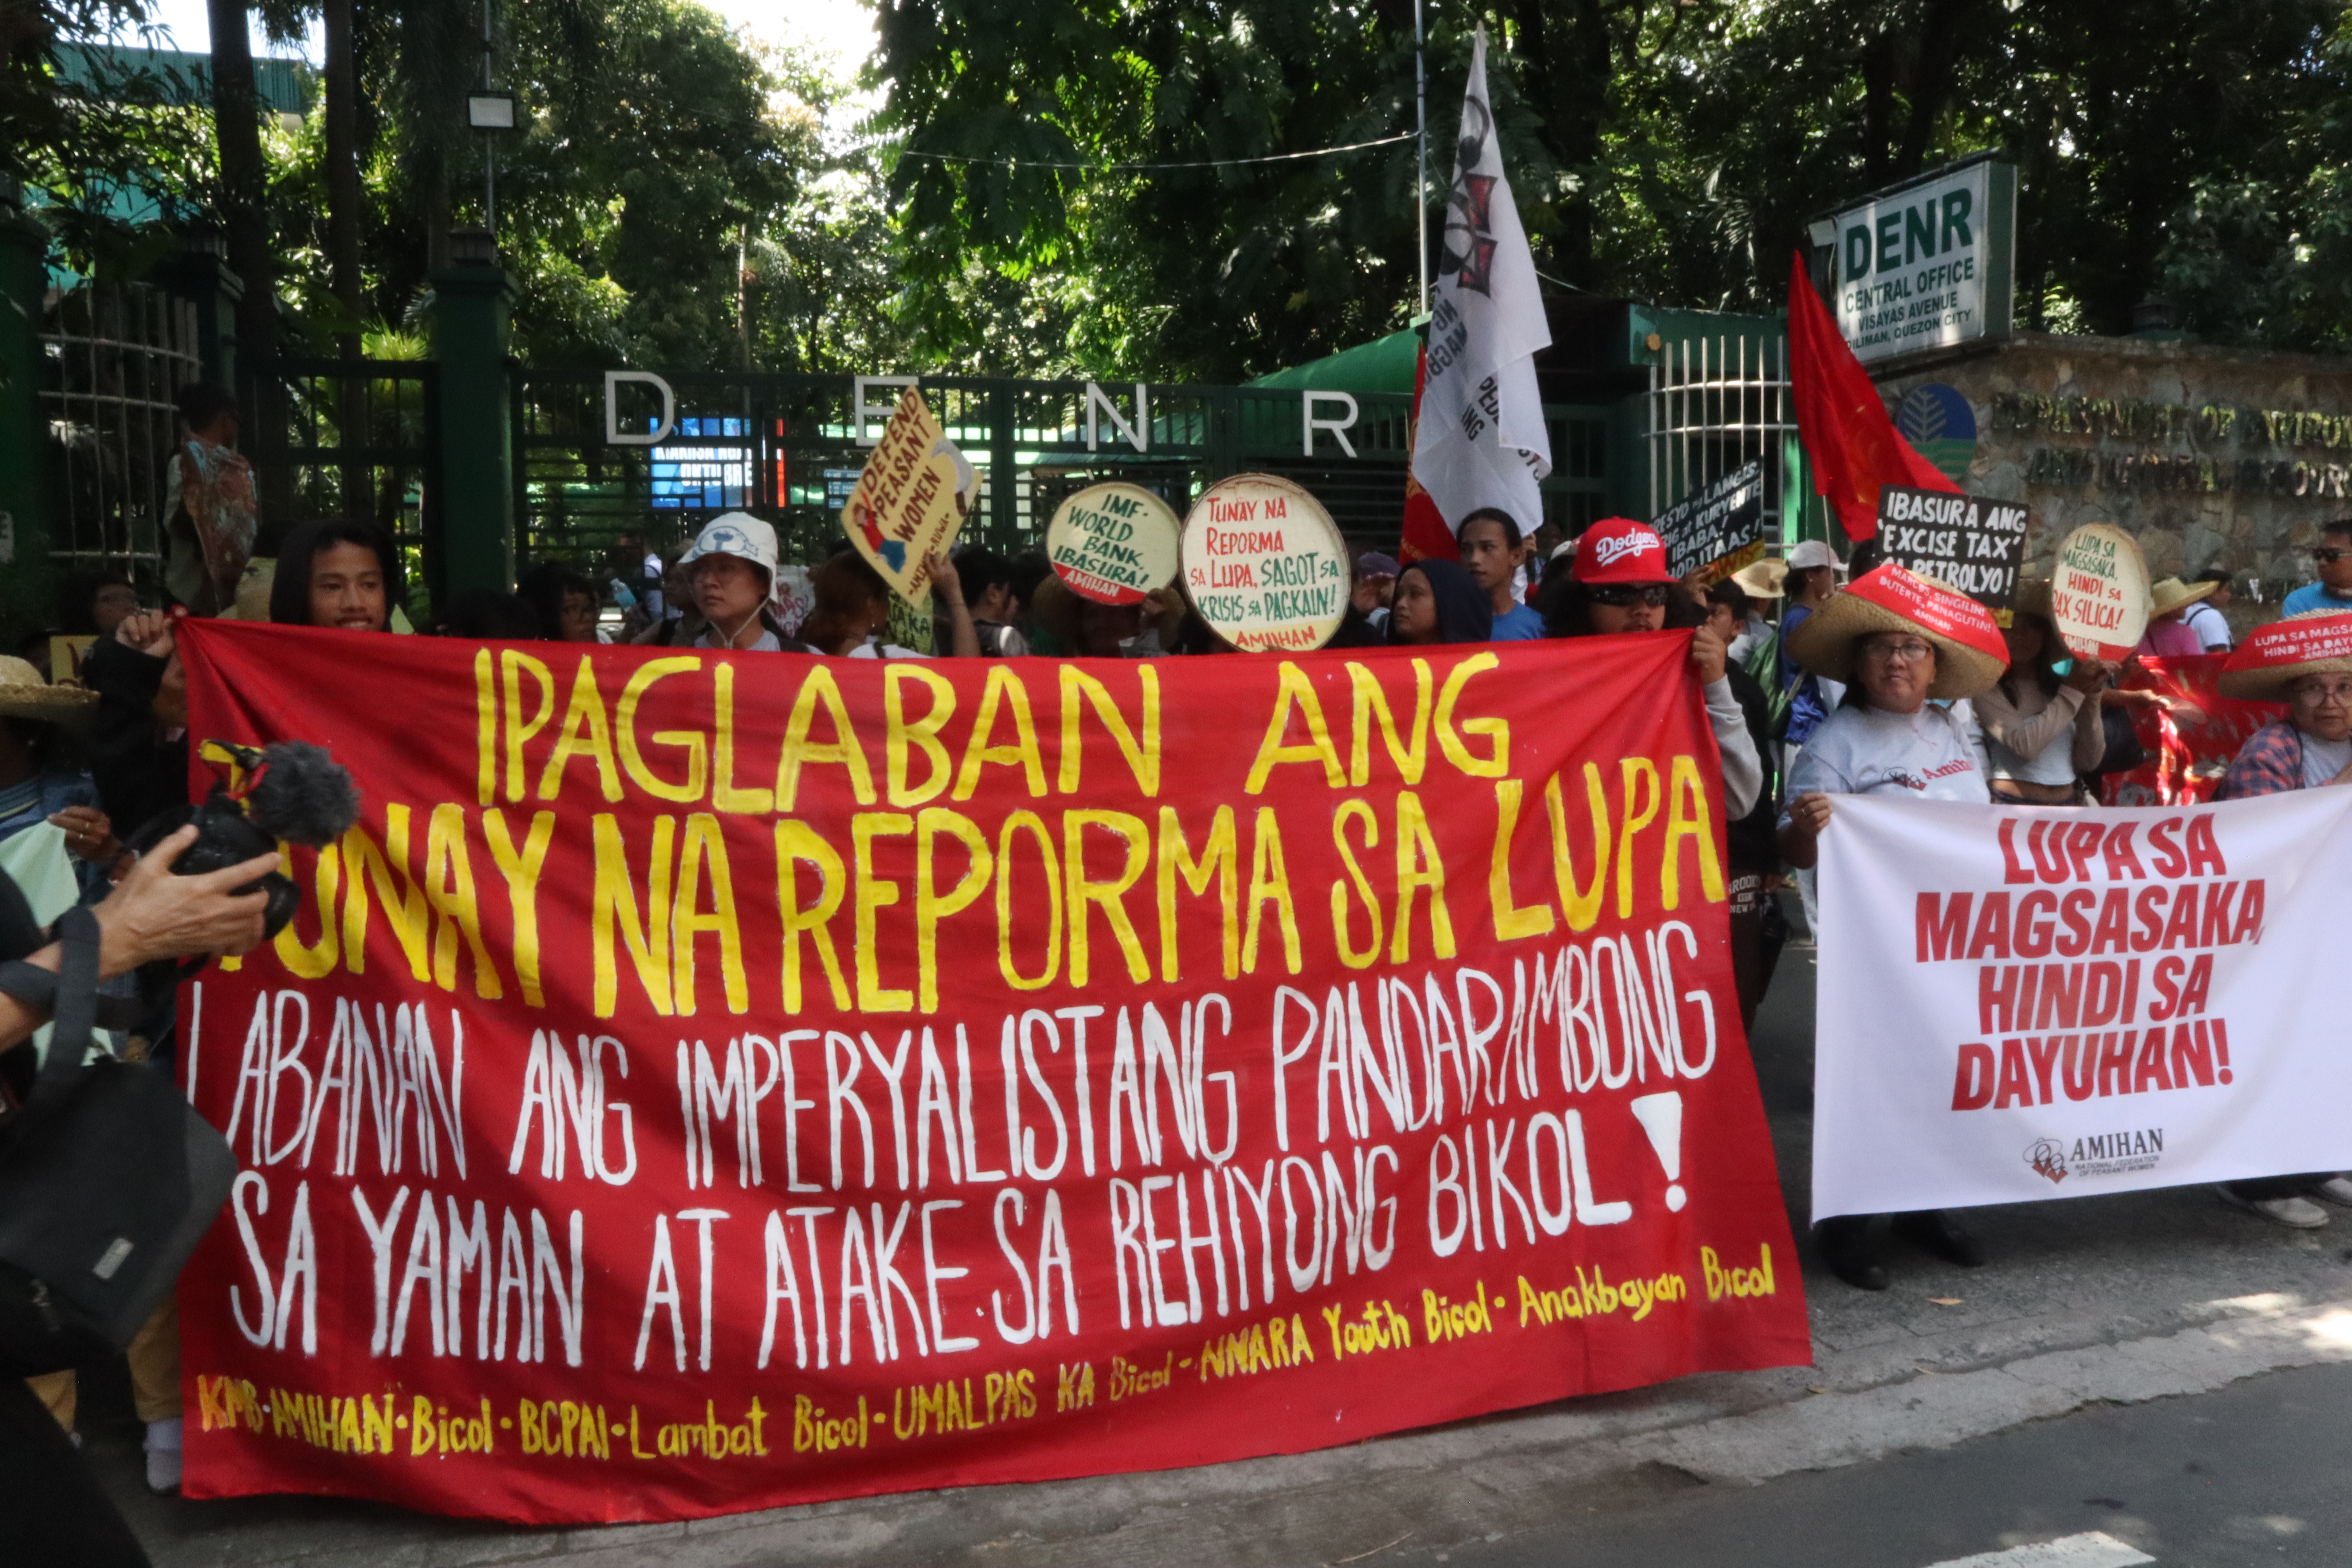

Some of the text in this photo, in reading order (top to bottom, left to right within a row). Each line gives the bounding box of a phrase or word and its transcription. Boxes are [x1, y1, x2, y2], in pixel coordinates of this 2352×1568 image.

[1846, 187, 1973, 283] DENR
[1846, 257, 1974, 314] CENTRAL OFFICE
[1858, 291, 1958, 332] VISAYAS AVENUE
[1894, 318, 1940, 338] QUEZON
[1945, 309, 1972, 326] CITY
[863, 392, 919, 495] DEFEND
[873, 414, 931, 521] PEASANT
[893, 465, 941, 543] WOMEN
[1068, 506, 1133, 542] WORLD
[1207, 497, 1287, 523] TUNAY NA
[1695, 477, 1761, 530] KURYENTE
[1887, 492, 2027, 533] IBASURA ANG
[1206, 527, 1285, 556] REPORMA
[1595, 528, 1660, 564] Dodgers
[2075, 533, 2116, 559] LUPA SA
[1054, 545, 1149, 587] IBASURA!
[1063, 570, 1120, 597] AMIHAN
[1190, 551, 1339, 590] SA LUPA, SAGOT SA
[2068, 572, 2122, 601] HINDI SA
[1198, 584, 1336, 622] KRISIS SA PAGKAIN!
[1879, 575, 1993, 633] DUTERTE, PANAGUTIN!
[1891, 567, 1986, 617] MARCOS, SINGILIN!
[2073, 598, 2125, 631] SILICA!
[2255, 633, 2287, 646] LUPA
[2289, 631, 2307, 641] SA
[2263, 645, 2300, 657] HINDI
[2303, 642, 2321, 652] SA
[475, 647, 1509, 814] IPAGLABAN ANG
[1997, 812, 2227, 885] LUPA SA
[220, 755, 1726, 1019] UNAY NA REPORMA SA LUPA
[1915, 878, 2266, 963] MAGSASAKA,
[1978, 953, 2214, 1035] HINDI SA
[508, 1028, 637, 1185] ANG
[676, 993, 1239, 1192] IMPERYALISTANG
[1272, 920, 1716, 1152] PANDARAMBONG
[1951, 1018, 2234, 1111] DAYUHAN!
[2069, 1128, 2163, 1161] AMIHAN
[2075, 1162, 2112, 1171] NATIONAL
[2091, 1165, 2125, 1175] PEASANT
[231, 1171, 317, 1359] SA
[352, 1185, 584, 1368] YAMAN
[634, 1208, 731, 1372] AT
[758, 1200, 979, 1370] ATAKE
[992, 1187, 1079, 1345] SA
[1109, 1145, 1398, 1329] REHIYONG
[630, 1396, 770, 1460] Lambat
[793, 1394, 868, 1453] Bicol
[1057, 1361, 1095, 1412] KA
[1109, 1350, 1173, 1402] Bicol
[1323, 1299, 1411, 1360] Youth
[1423, 1279, 1492, 1344] Bicol
[1517, 1263, 1686, 1328] Anakbayan
[1700, 1242, 1776, 1301] Bicol
